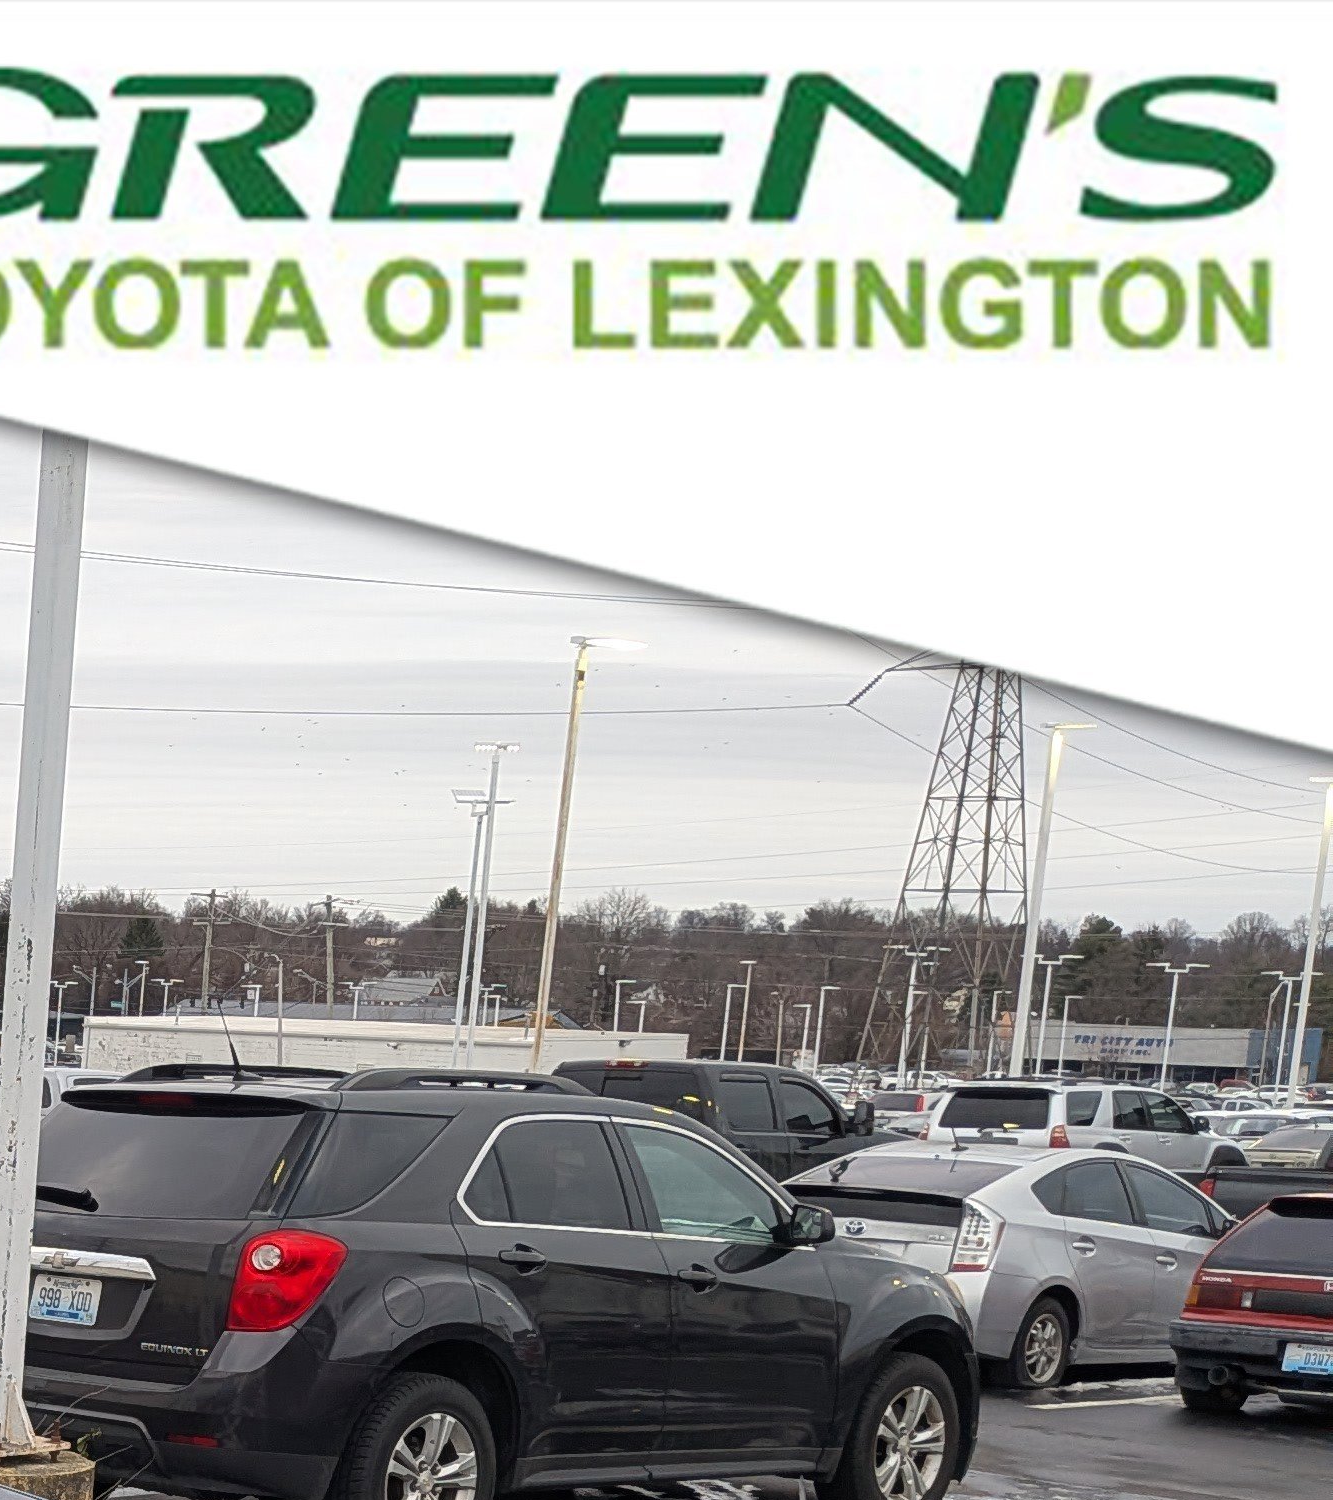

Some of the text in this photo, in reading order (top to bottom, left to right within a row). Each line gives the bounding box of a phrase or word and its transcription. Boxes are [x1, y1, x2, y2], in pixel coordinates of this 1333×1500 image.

[1074, 1034, 1097, 1045] TRI
[1100, 1035, 1134, 1047] CITY
[38, 1286, 62, 1309] 998
[140, 1342, 209, 1357] EQUINOX LT
[1303, 1352, 1333, 1367] D3W7
